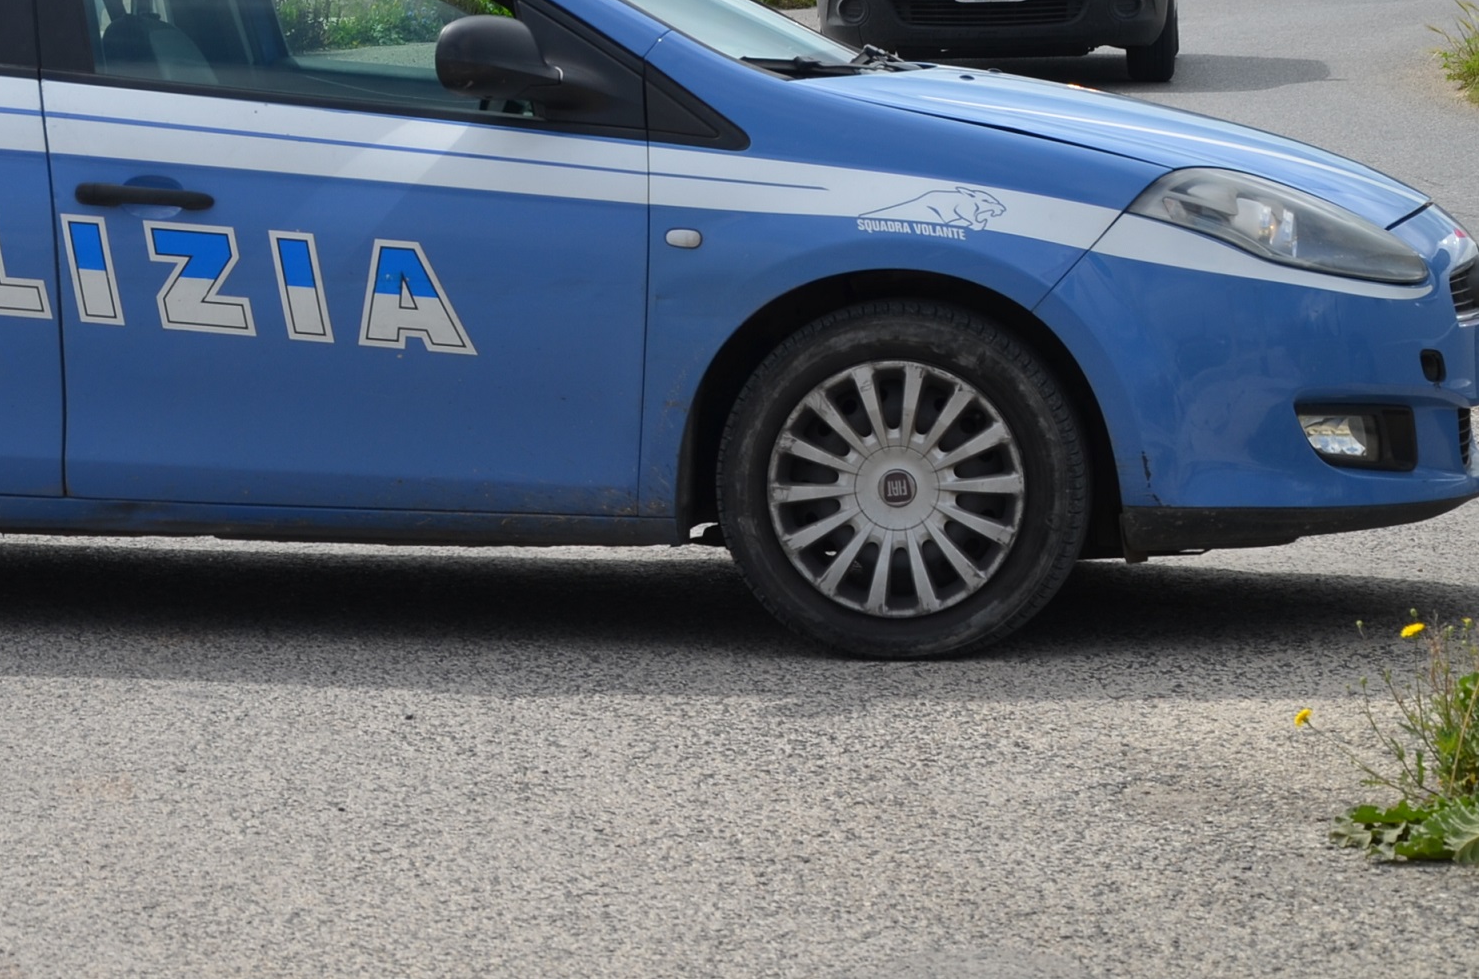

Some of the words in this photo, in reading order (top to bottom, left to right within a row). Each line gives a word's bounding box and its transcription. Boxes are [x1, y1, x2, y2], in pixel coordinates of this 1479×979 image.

[857, 219, 911, 233] SQUADRA
[913, 223, 966, 240] VOLANTE
[886, 479, 908, 497] FIAT
